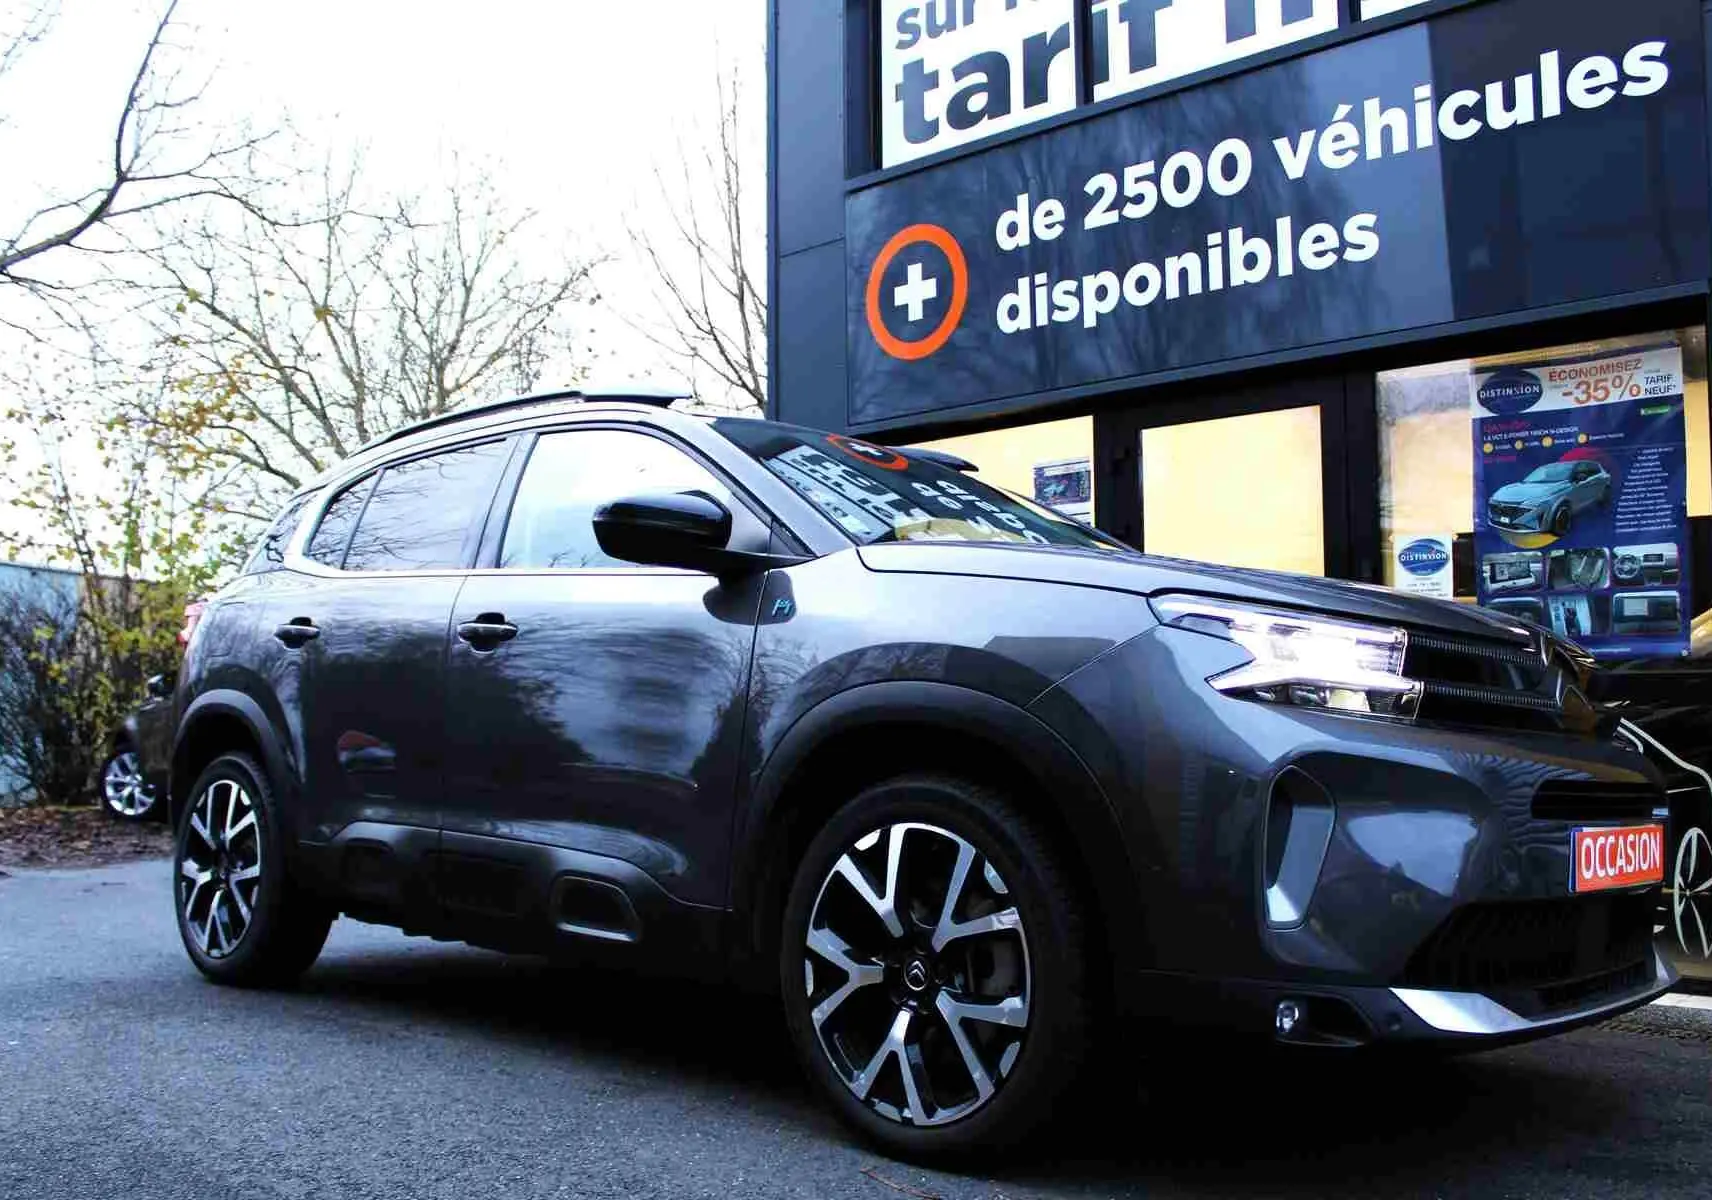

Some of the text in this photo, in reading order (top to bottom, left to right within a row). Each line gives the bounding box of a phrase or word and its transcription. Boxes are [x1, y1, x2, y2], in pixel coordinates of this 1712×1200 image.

[996, 41, 1669, 251] de 2500 véhicules
[996, 213, 1380, 334] disponibles
[1562, 372, 1641, 405] -35%
[1643, 374, 1673, 386] TARIF
[1580, 832, 1660, 879] OCCASION
